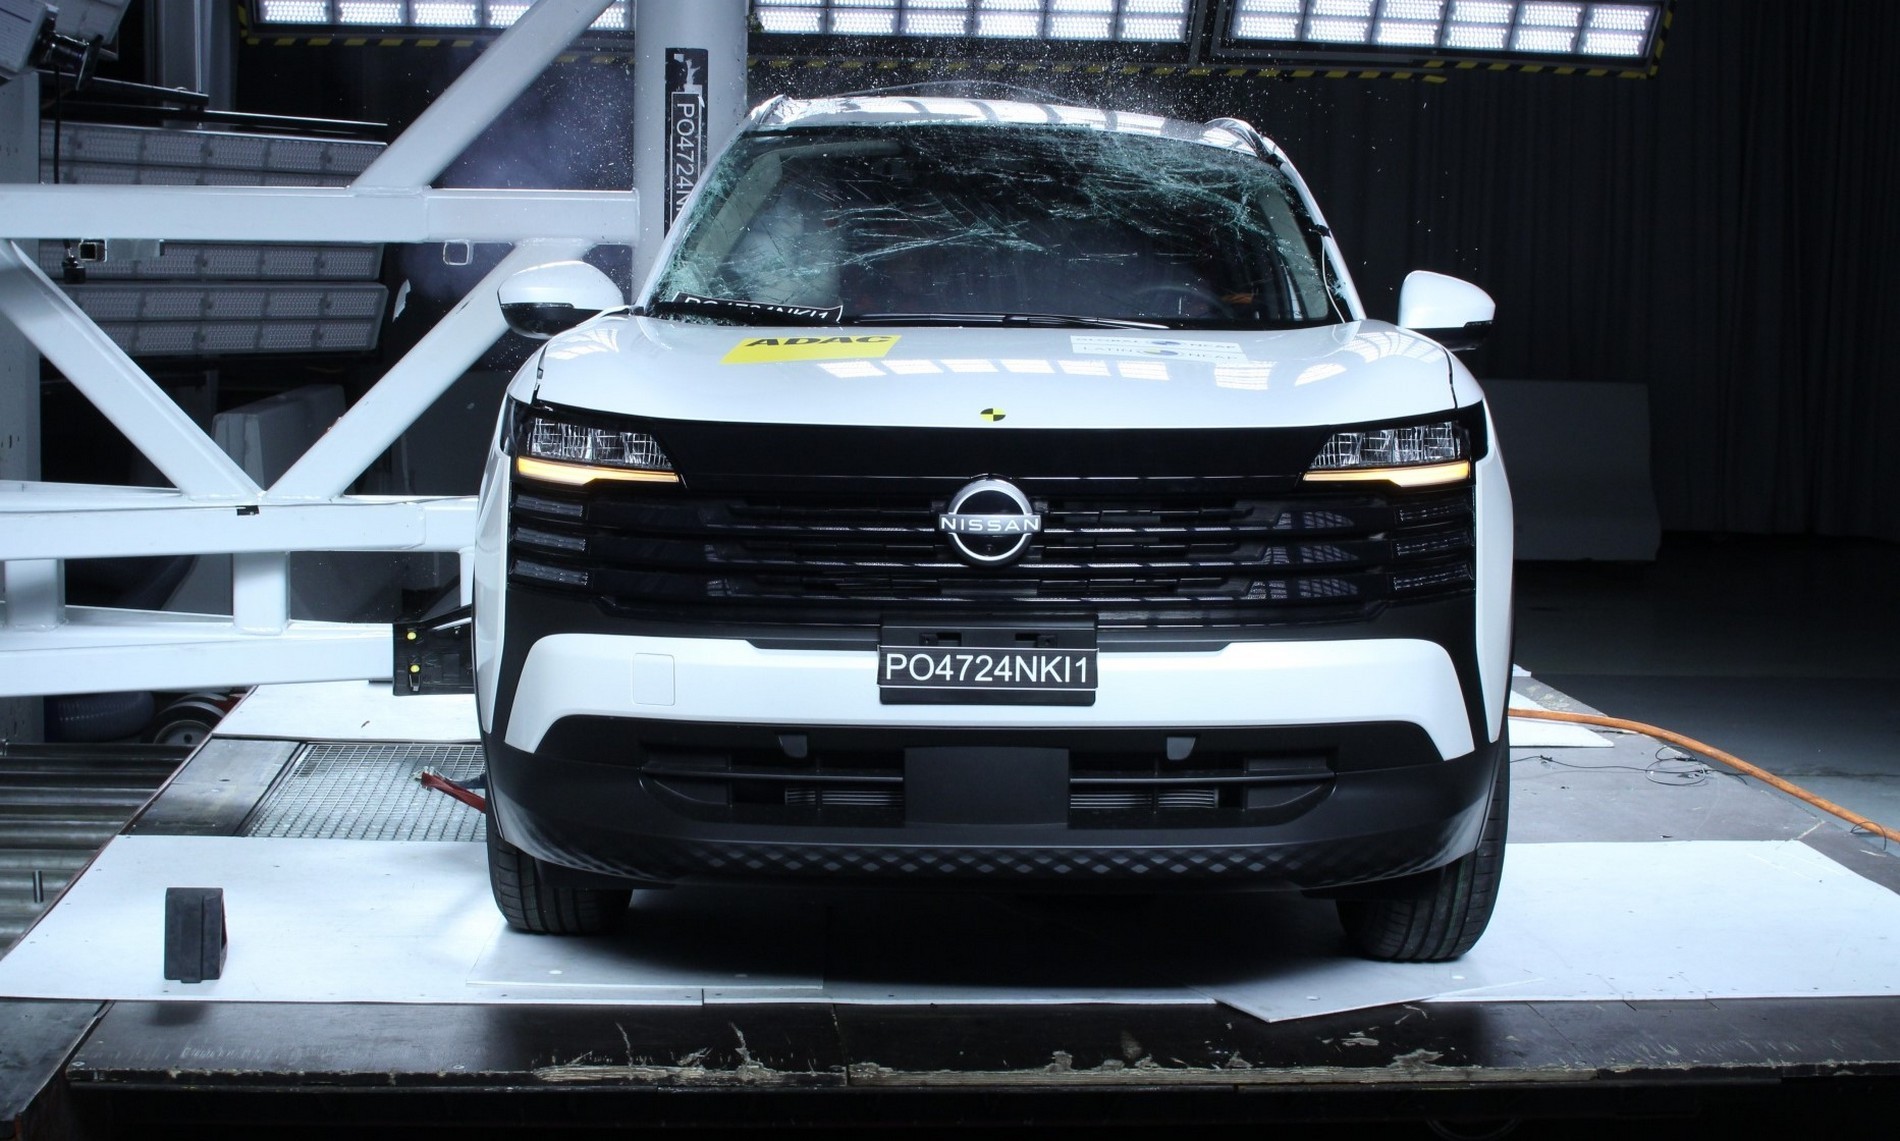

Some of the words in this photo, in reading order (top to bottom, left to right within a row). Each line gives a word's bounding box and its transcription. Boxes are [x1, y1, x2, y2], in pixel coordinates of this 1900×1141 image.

[676, 103, 695, 211] PO4724N
[745, 336, 892, 347] ADAC
[941, 517, 1039, 531] NISSAN
[886, 653, 1087, 683] PO4724NKI1
